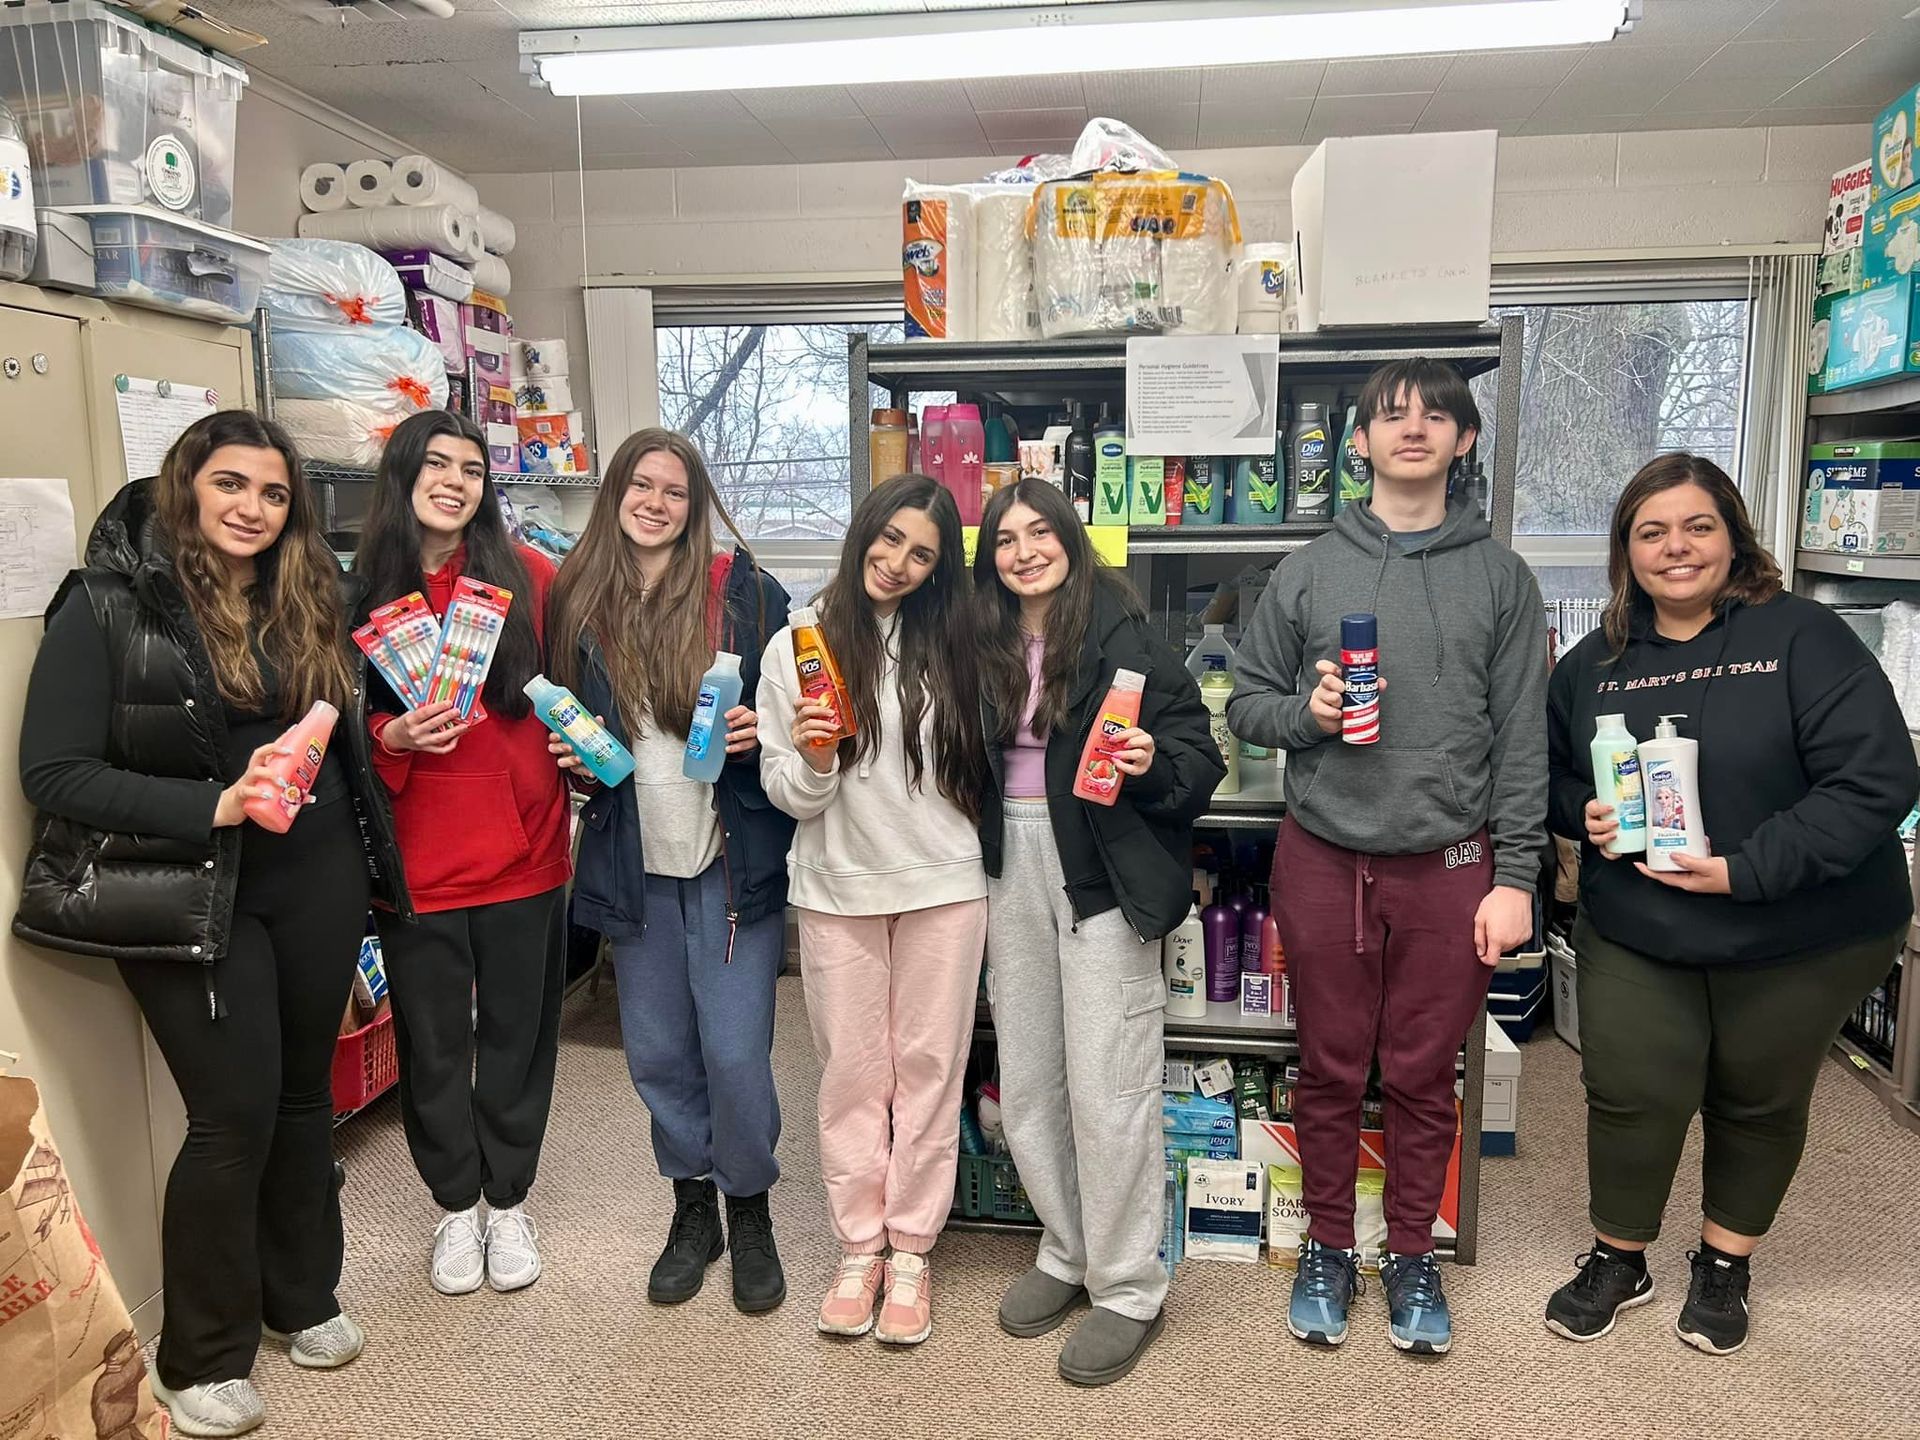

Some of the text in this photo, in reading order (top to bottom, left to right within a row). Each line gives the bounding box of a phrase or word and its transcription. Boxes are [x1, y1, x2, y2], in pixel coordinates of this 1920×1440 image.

[1830, 167, 1873, 198] HUGGIES
[1301, 443, 1325, 455] Dial
[801, 660, 820, 674] VO5
[1624, 671, 1686, 691] MARY'S
[1729, 659, 1779, 675] TEAM
[1346, 680, 1378, 693] Barbas
[1444, 841, 1483, 869] GAP
[1172, 934, 1193, 945] Dove
[1213, 1119, 1234, 1129] Dial
[1210, 1136, 1231, 1145] Dial
[1206, 1193, 1245, 1206] IVORY
[1277, 1197, 1304, 1208] BAR
